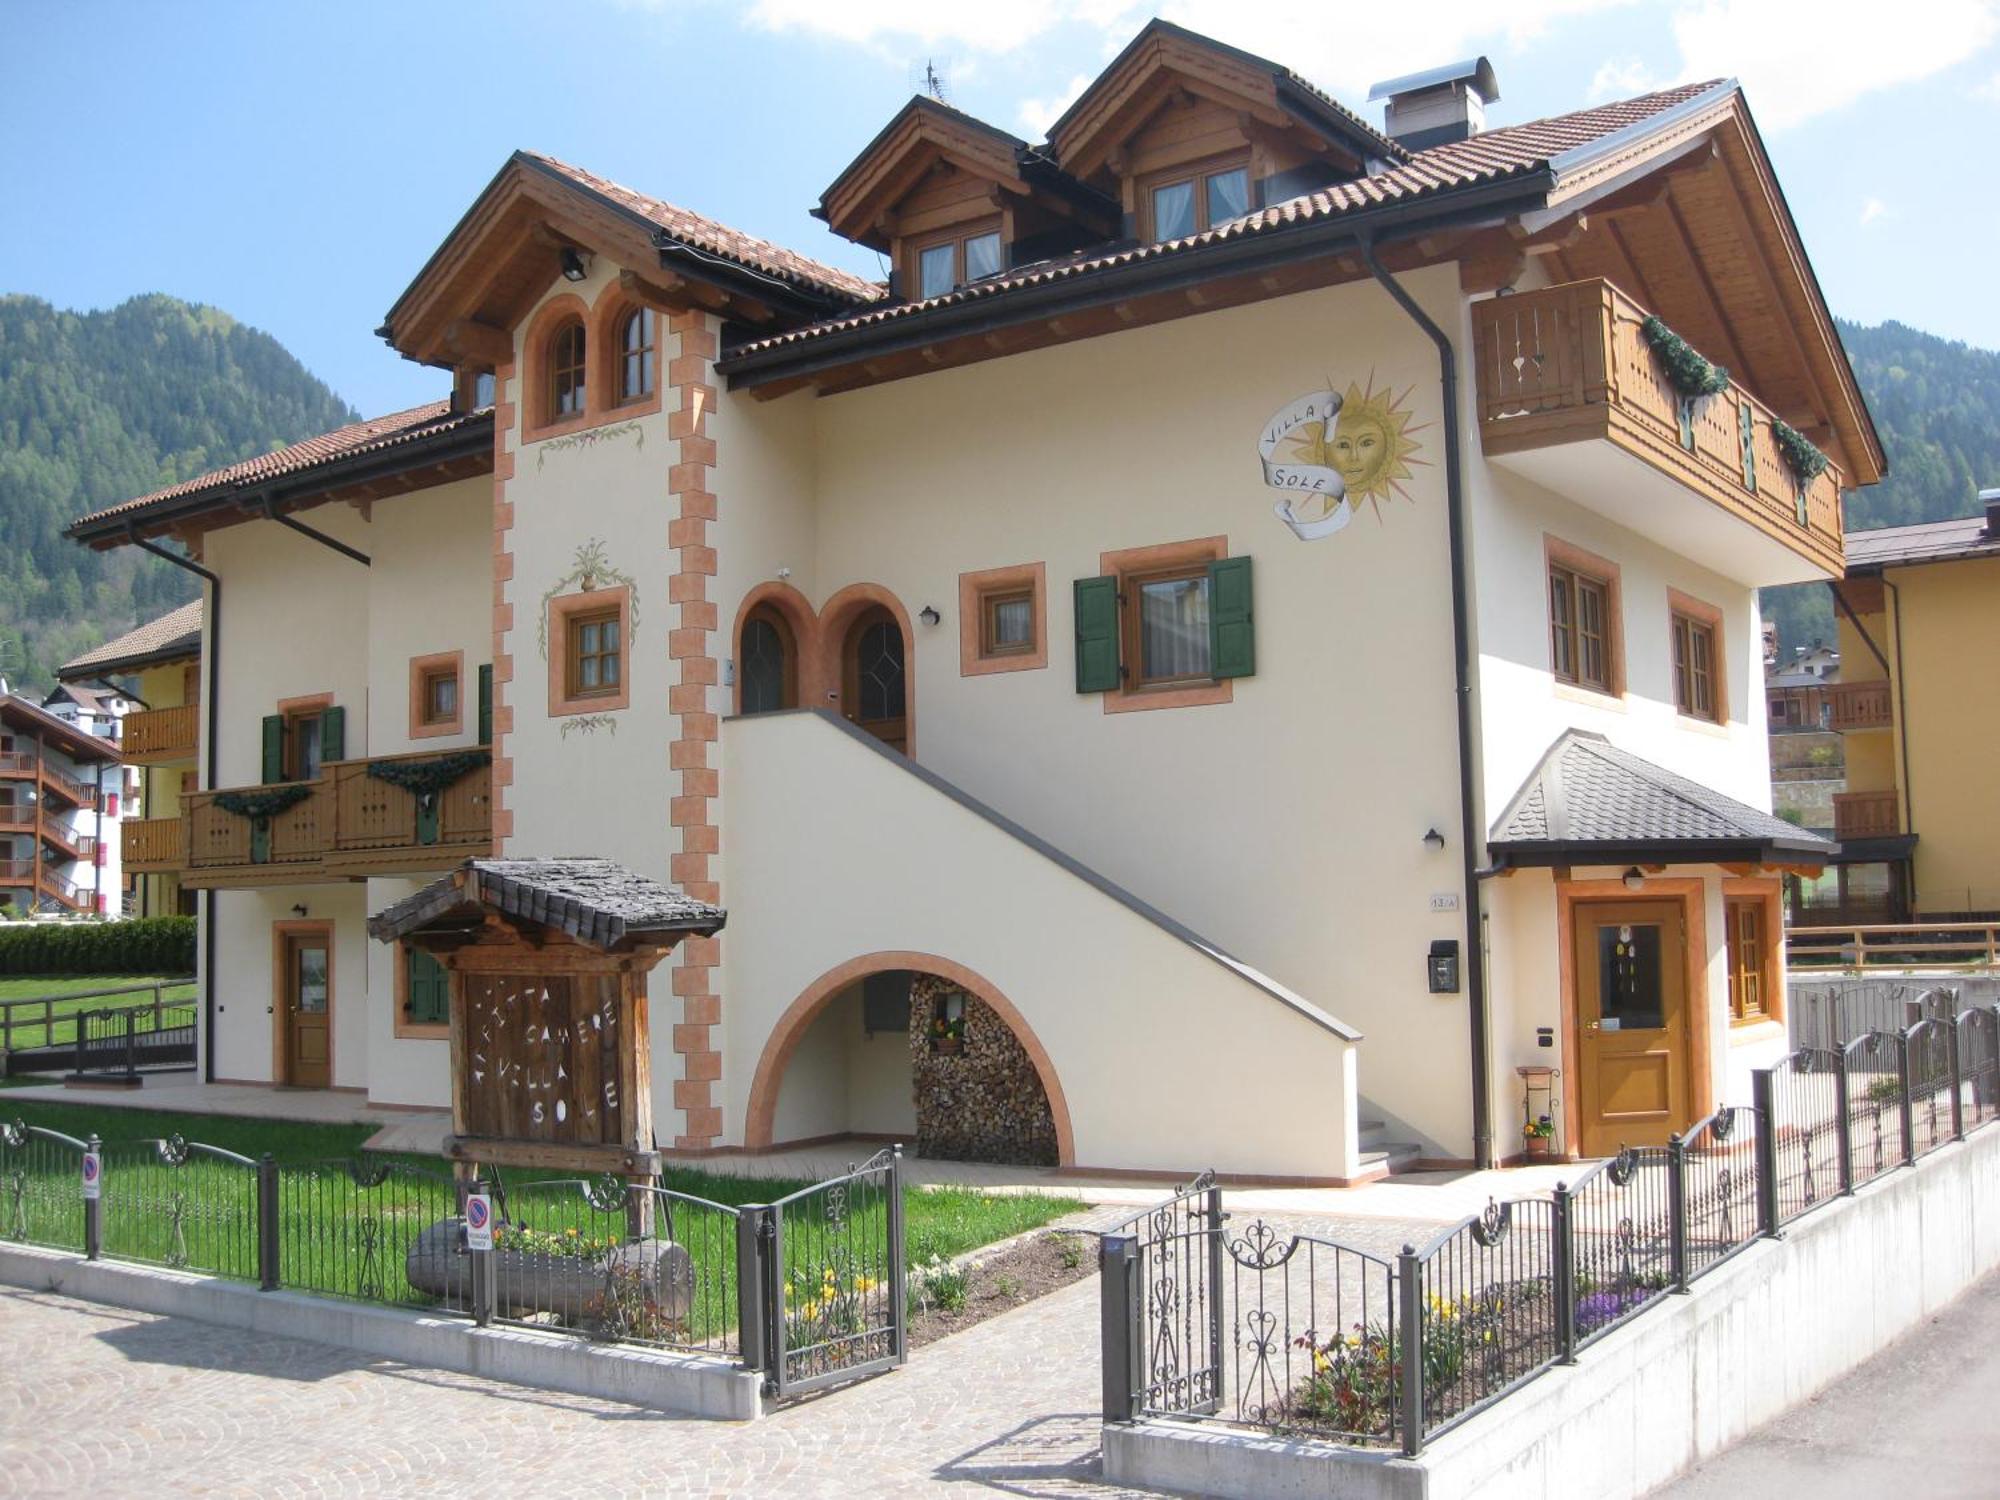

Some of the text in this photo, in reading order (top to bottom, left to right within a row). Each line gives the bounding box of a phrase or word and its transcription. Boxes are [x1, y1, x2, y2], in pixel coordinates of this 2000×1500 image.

[1265, 404, 1315, 445] VILLA
[1273, 468, 1326, 490] SOLE
[525, 1000, 617, 1045] CAMERE
[498, 1057, 568, 1090] VILLA
[532, 1081, 619, 1124] SOLE
